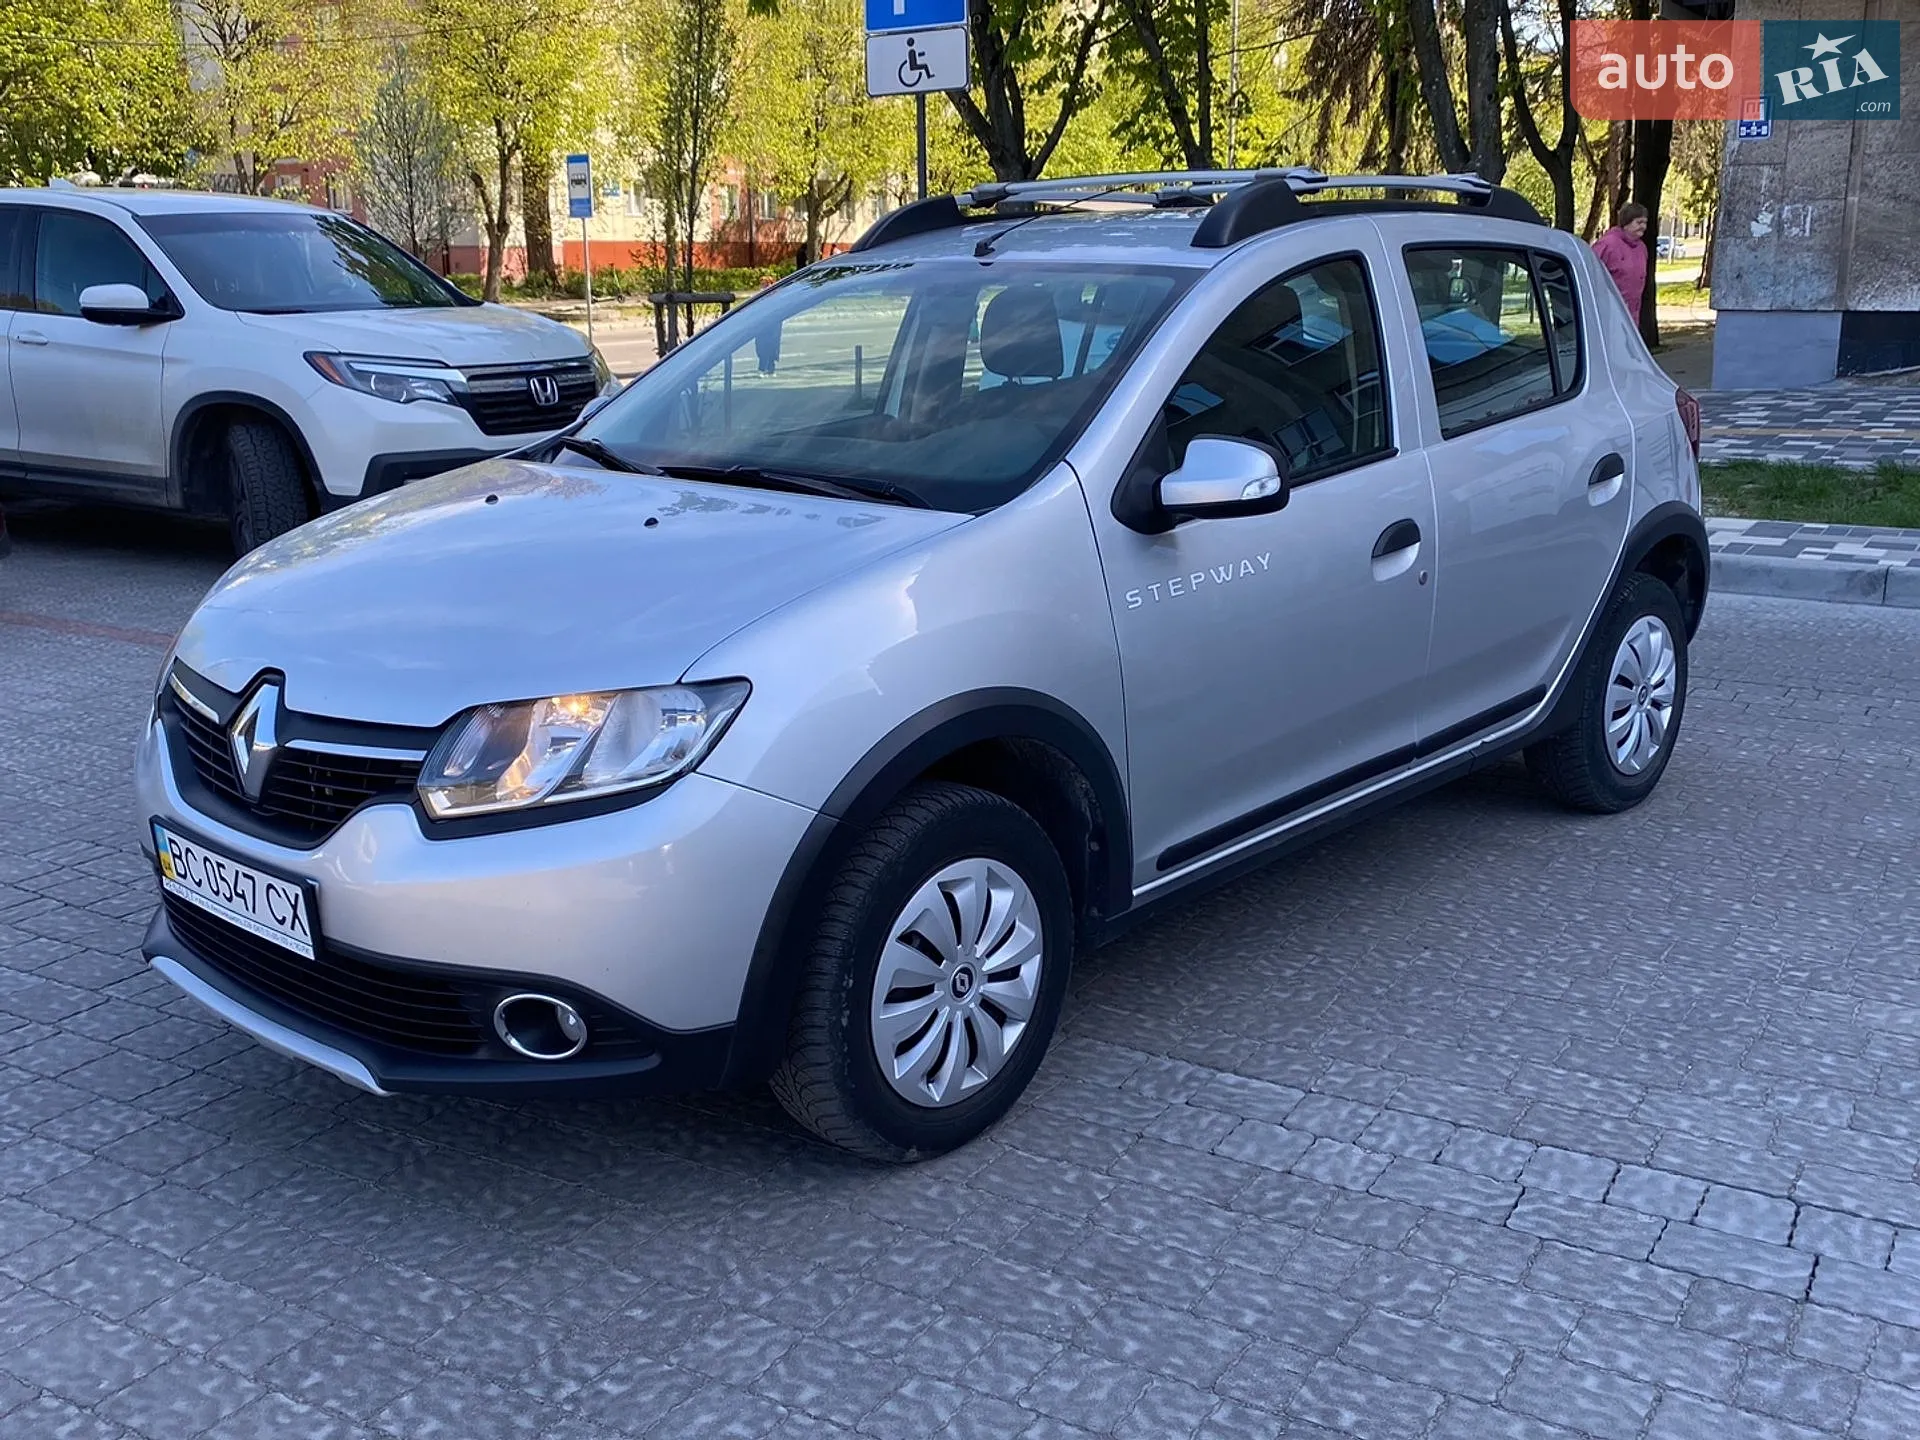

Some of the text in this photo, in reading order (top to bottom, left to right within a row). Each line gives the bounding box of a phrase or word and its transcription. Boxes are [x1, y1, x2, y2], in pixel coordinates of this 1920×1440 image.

[1125, 552, 1272, 609] STEPWAY
[167, 837, 202, 888] BC
[203, 856, 257, 914] 0547
[266, 883, 309, 937] CX
